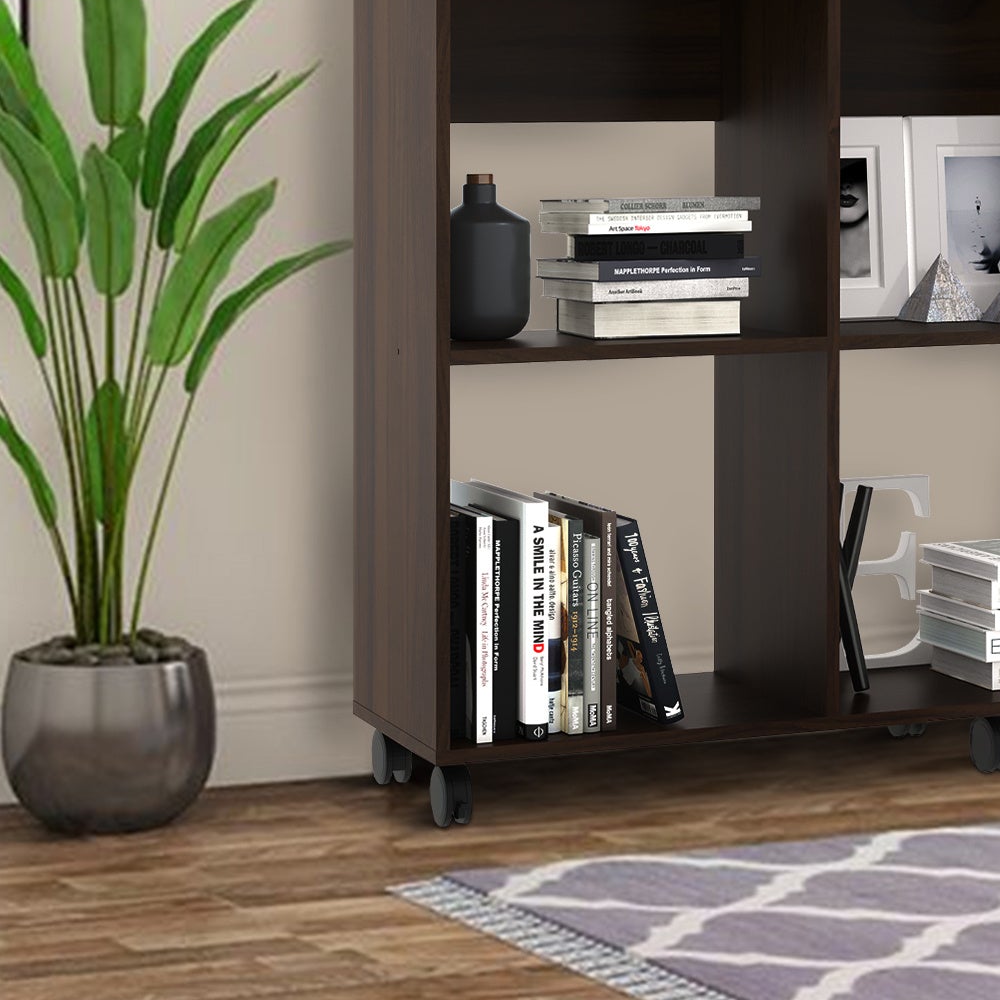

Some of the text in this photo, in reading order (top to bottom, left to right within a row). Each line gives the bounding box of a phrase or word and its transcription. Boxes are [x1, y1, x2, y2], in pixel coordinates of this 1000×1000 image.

[573, 533, 582, 568] Picasso
[533, 525, 544, 653] A SMILE IN THE MIND
[573, 569, 582, 607] Guitars
[587, 583, 598, 602] ON
[633, 576, 648, 609] Fashion
[548, 602, 556, 621] design
[587, 609, 598, 639] LINE
[605, 599, 613, 660] tangled alphabets
